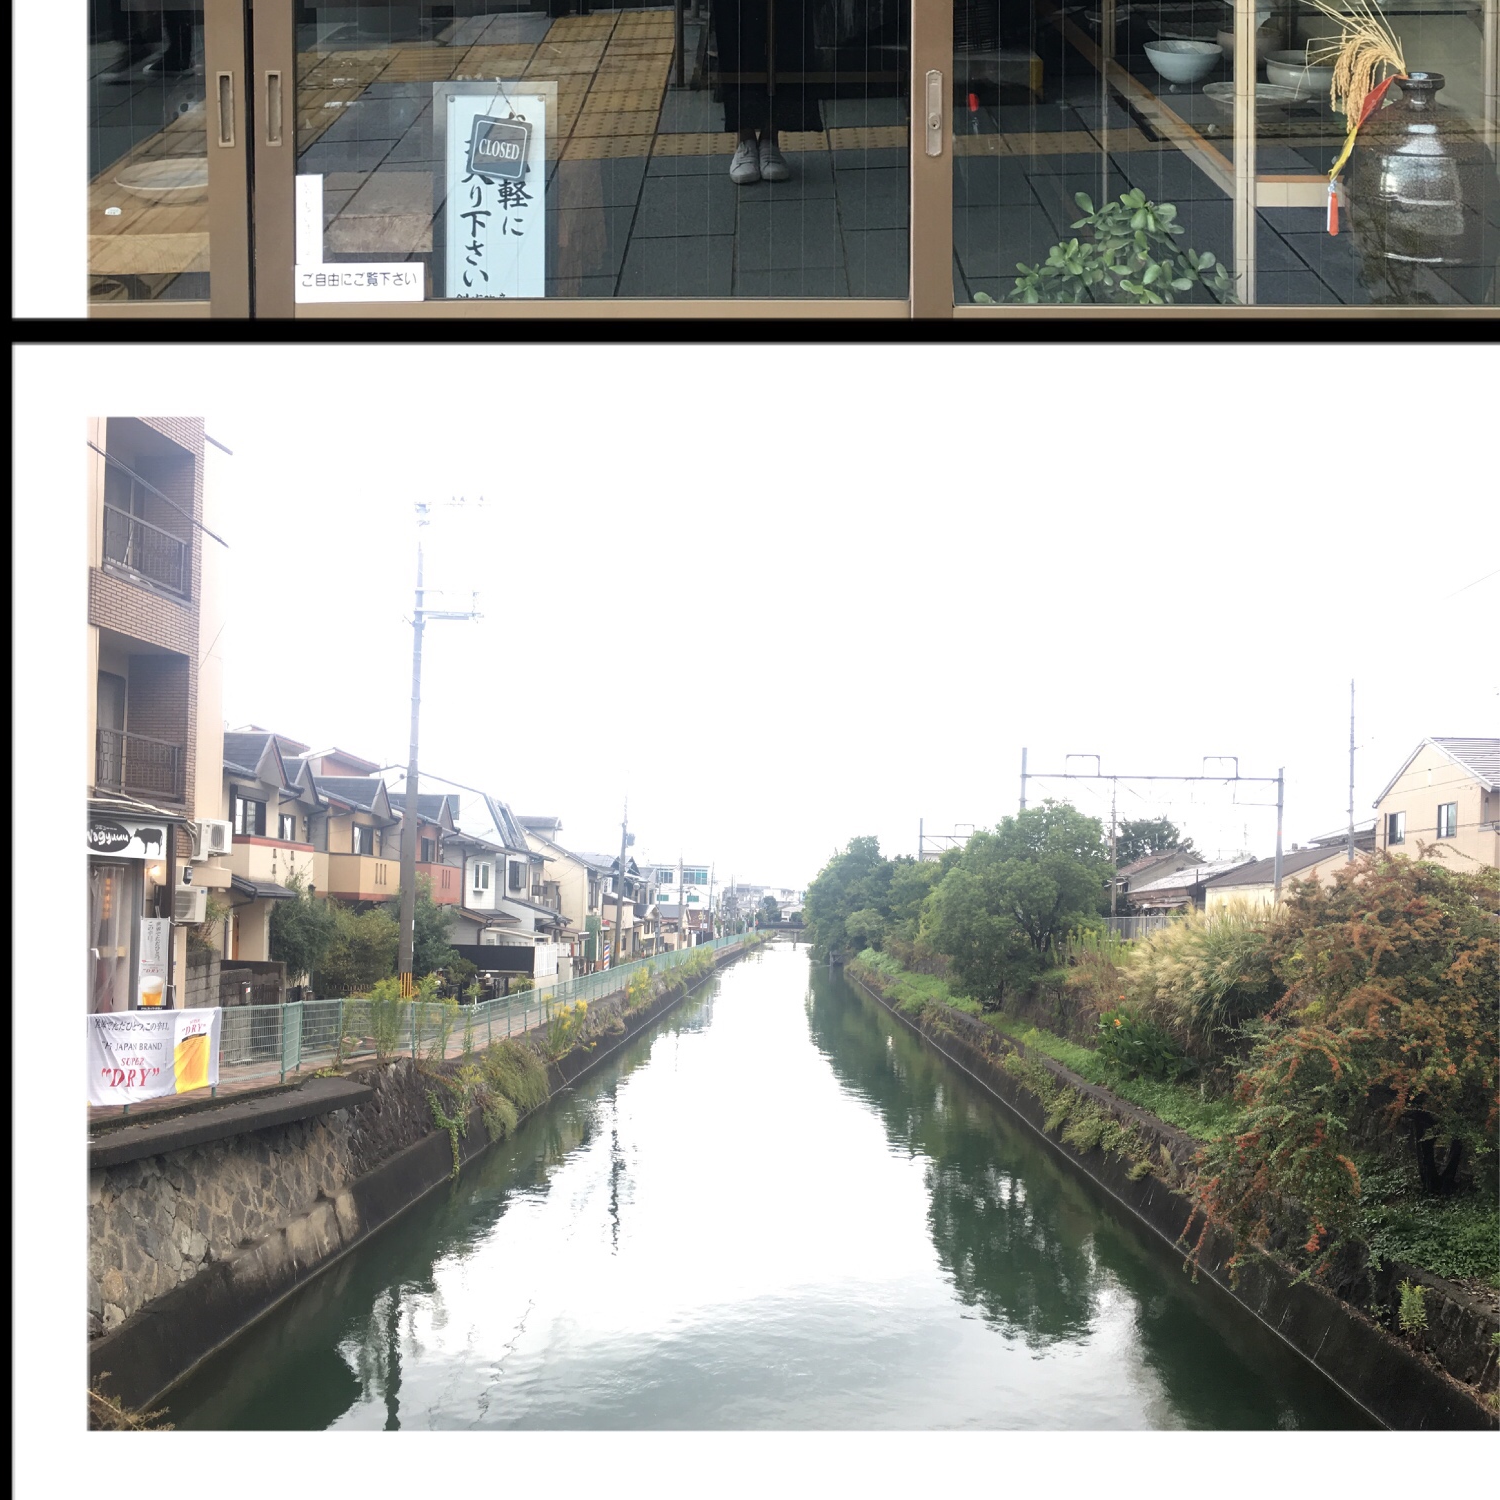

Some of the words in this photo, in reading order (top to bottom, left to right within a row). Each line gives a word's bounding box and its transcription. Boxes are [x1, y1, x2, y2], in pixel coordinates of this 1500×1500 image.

[477, 138, 520, 161] CLOSED
[301, 271, 417, 288] ご自由にご覧下さい
[138, 1041, 163, 1051] BRAND
